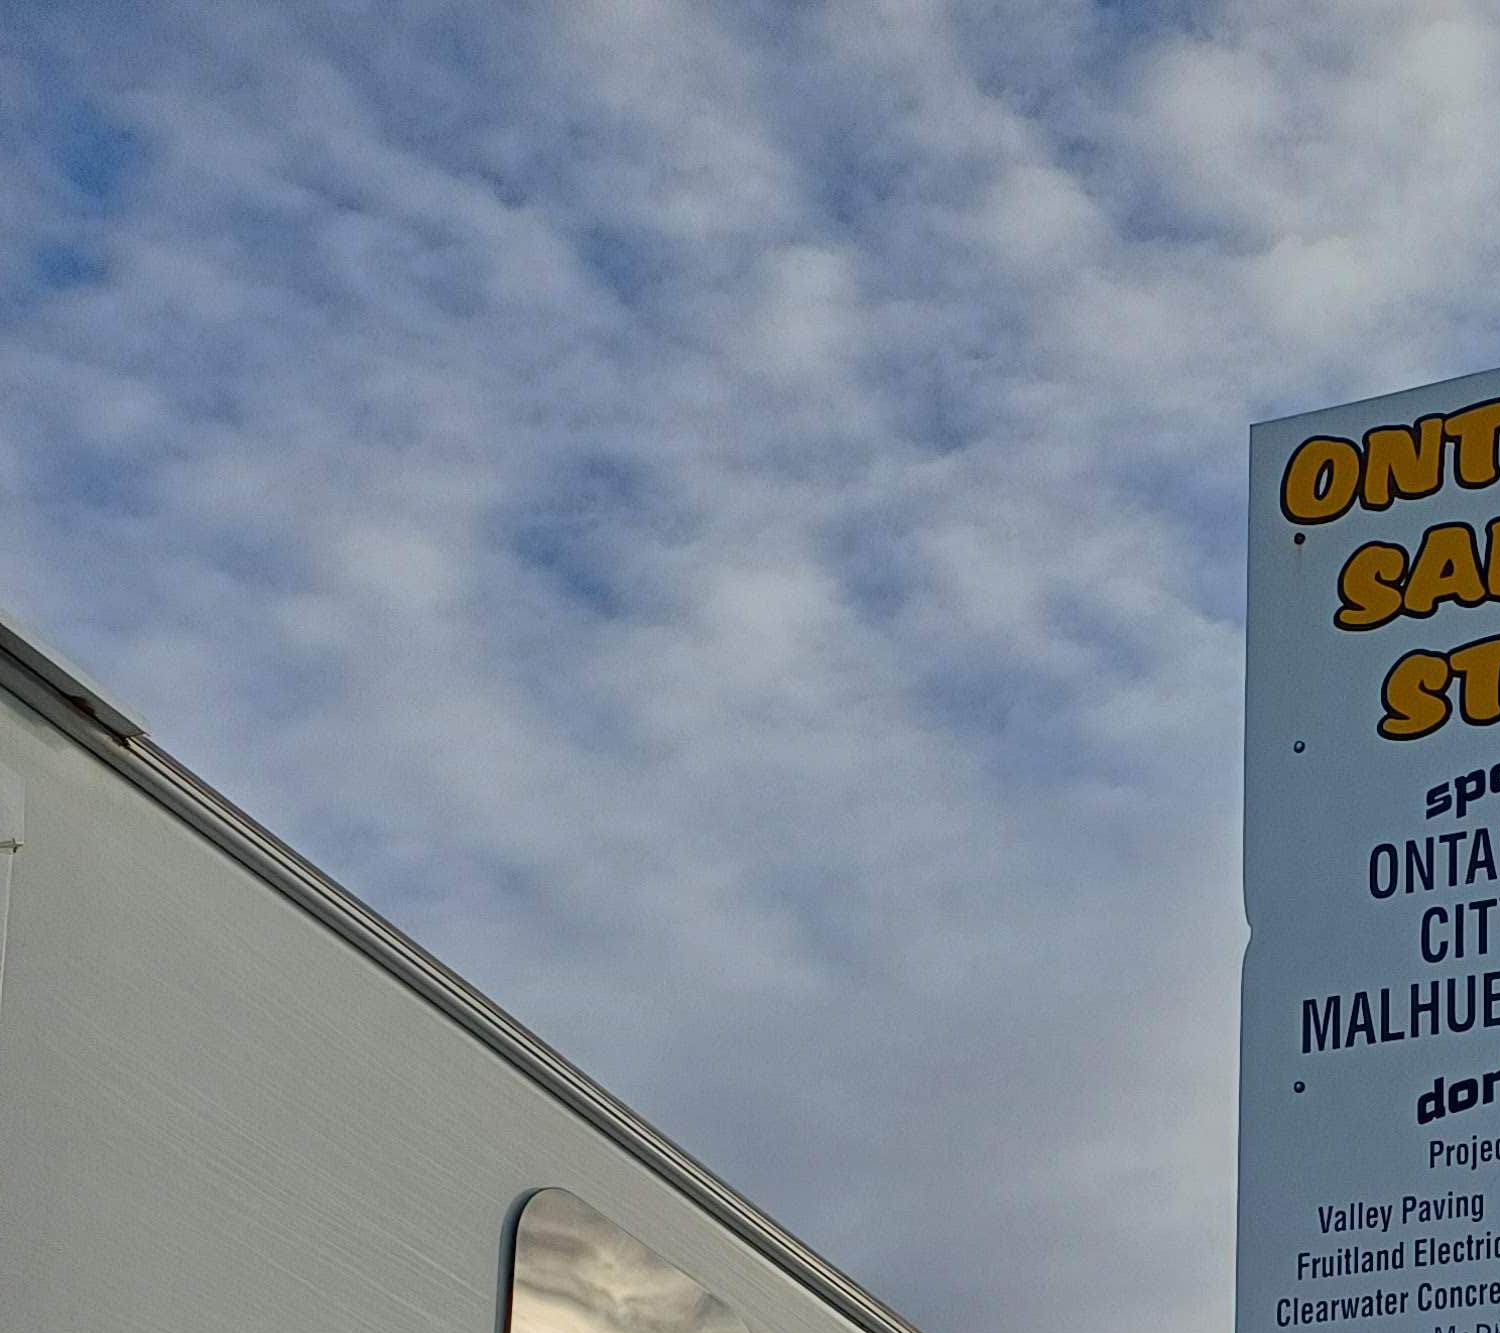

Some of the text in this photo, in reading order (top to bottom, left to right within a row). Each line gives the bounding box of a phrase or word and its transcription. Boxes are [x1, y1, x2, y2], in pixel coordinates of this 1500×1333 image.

[1319, 1191, 1484, 1234] Valley Paving
[1298, 1242, 1403, 1281] Fruitland
[1277, 1288, 1408, 1327] Clearwater
